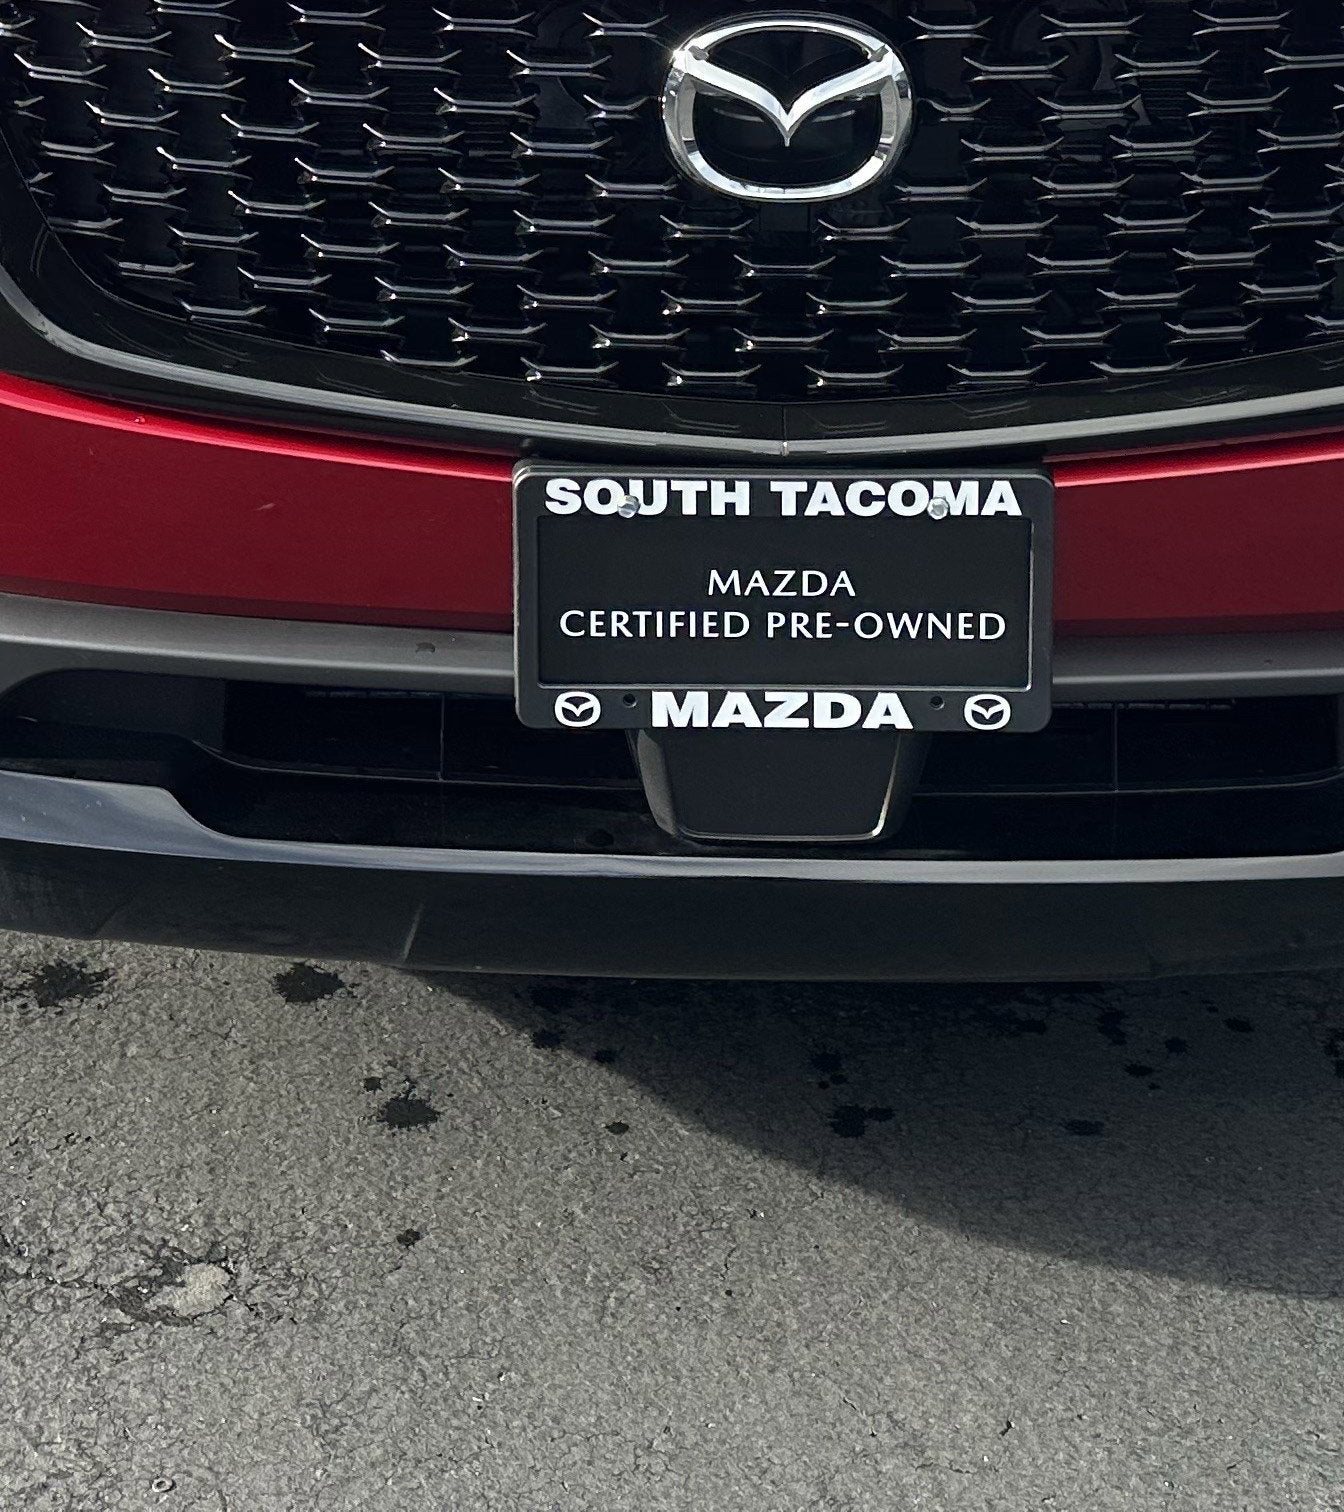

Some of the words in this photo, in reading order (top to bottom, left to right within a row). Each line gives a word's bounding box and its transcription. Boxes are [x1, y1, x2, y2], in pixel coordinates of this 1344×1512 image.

[544, 478, 751, 517] SOUTH
[770, 479, 1023, 517] TACOMA
[707, 568, 857, 598] MAZDA
[559, 610, 751, 639] CERTIFIED
[766, 611, 1008, 640] PRE-OWNED
[650, 691, 914, 730] MAZDA
